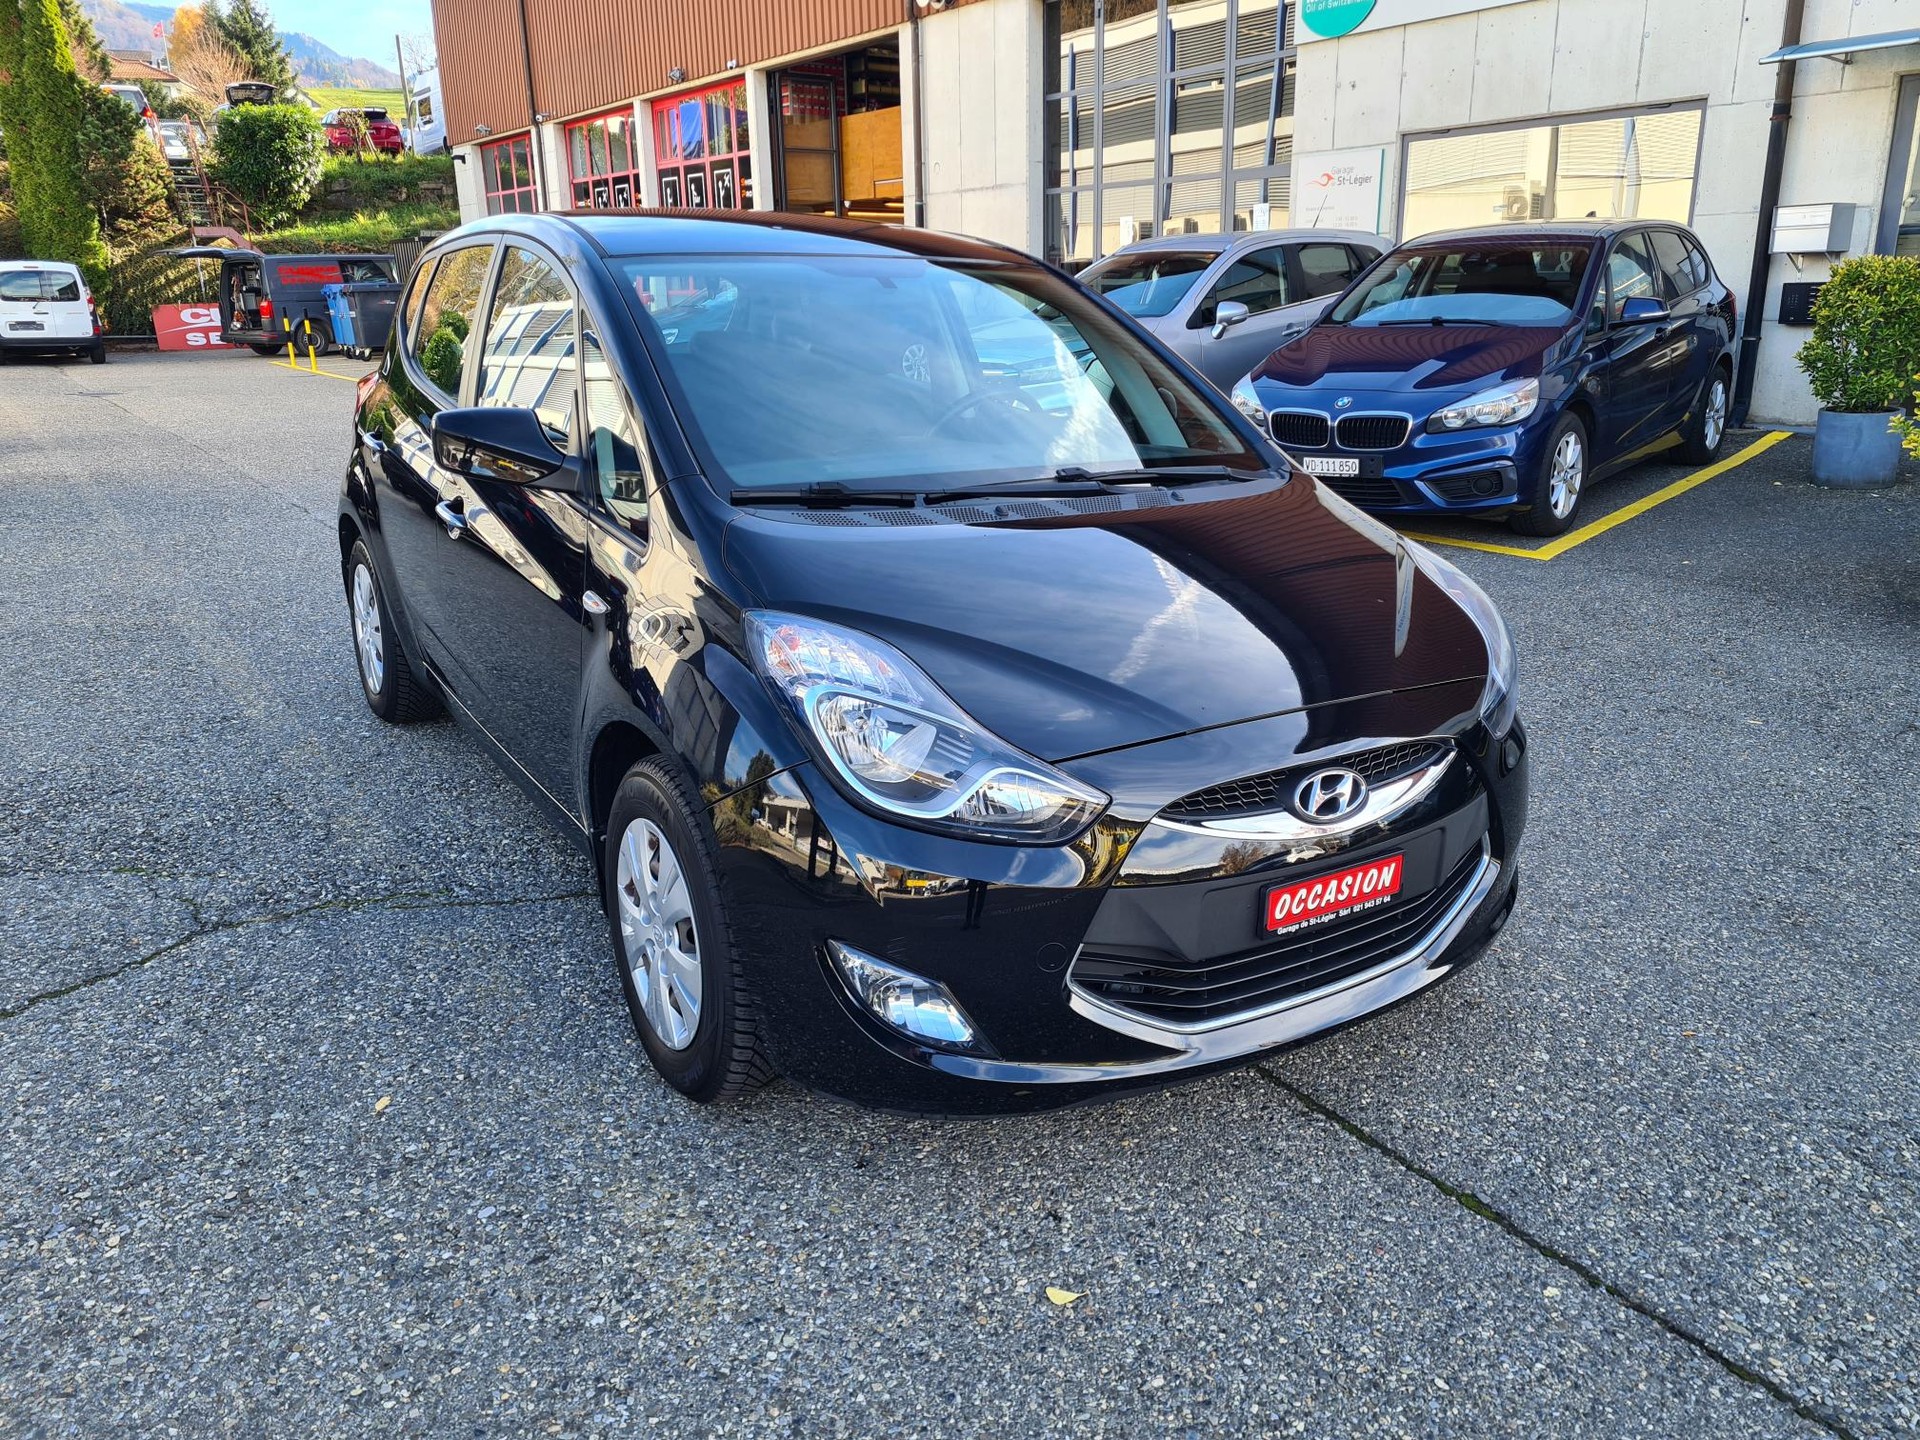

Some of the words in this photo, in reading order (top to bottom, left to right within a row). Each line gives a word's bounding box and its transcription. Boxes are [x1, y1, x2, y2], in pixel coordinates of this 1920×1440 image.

[1331, 166, 1355, 176] Garage
[1337, 173, 1373, 187] St-Légier
[1274, 862, 1396, 920] OCCASION
[1277, 924, 1300, 935] Garage
[1300, 920, 1309, 929] de
[1352, 903, 1364, 912] 021
[1364, 900, 1376, 909] 943
[1383, 894, 1391, 903] 64
